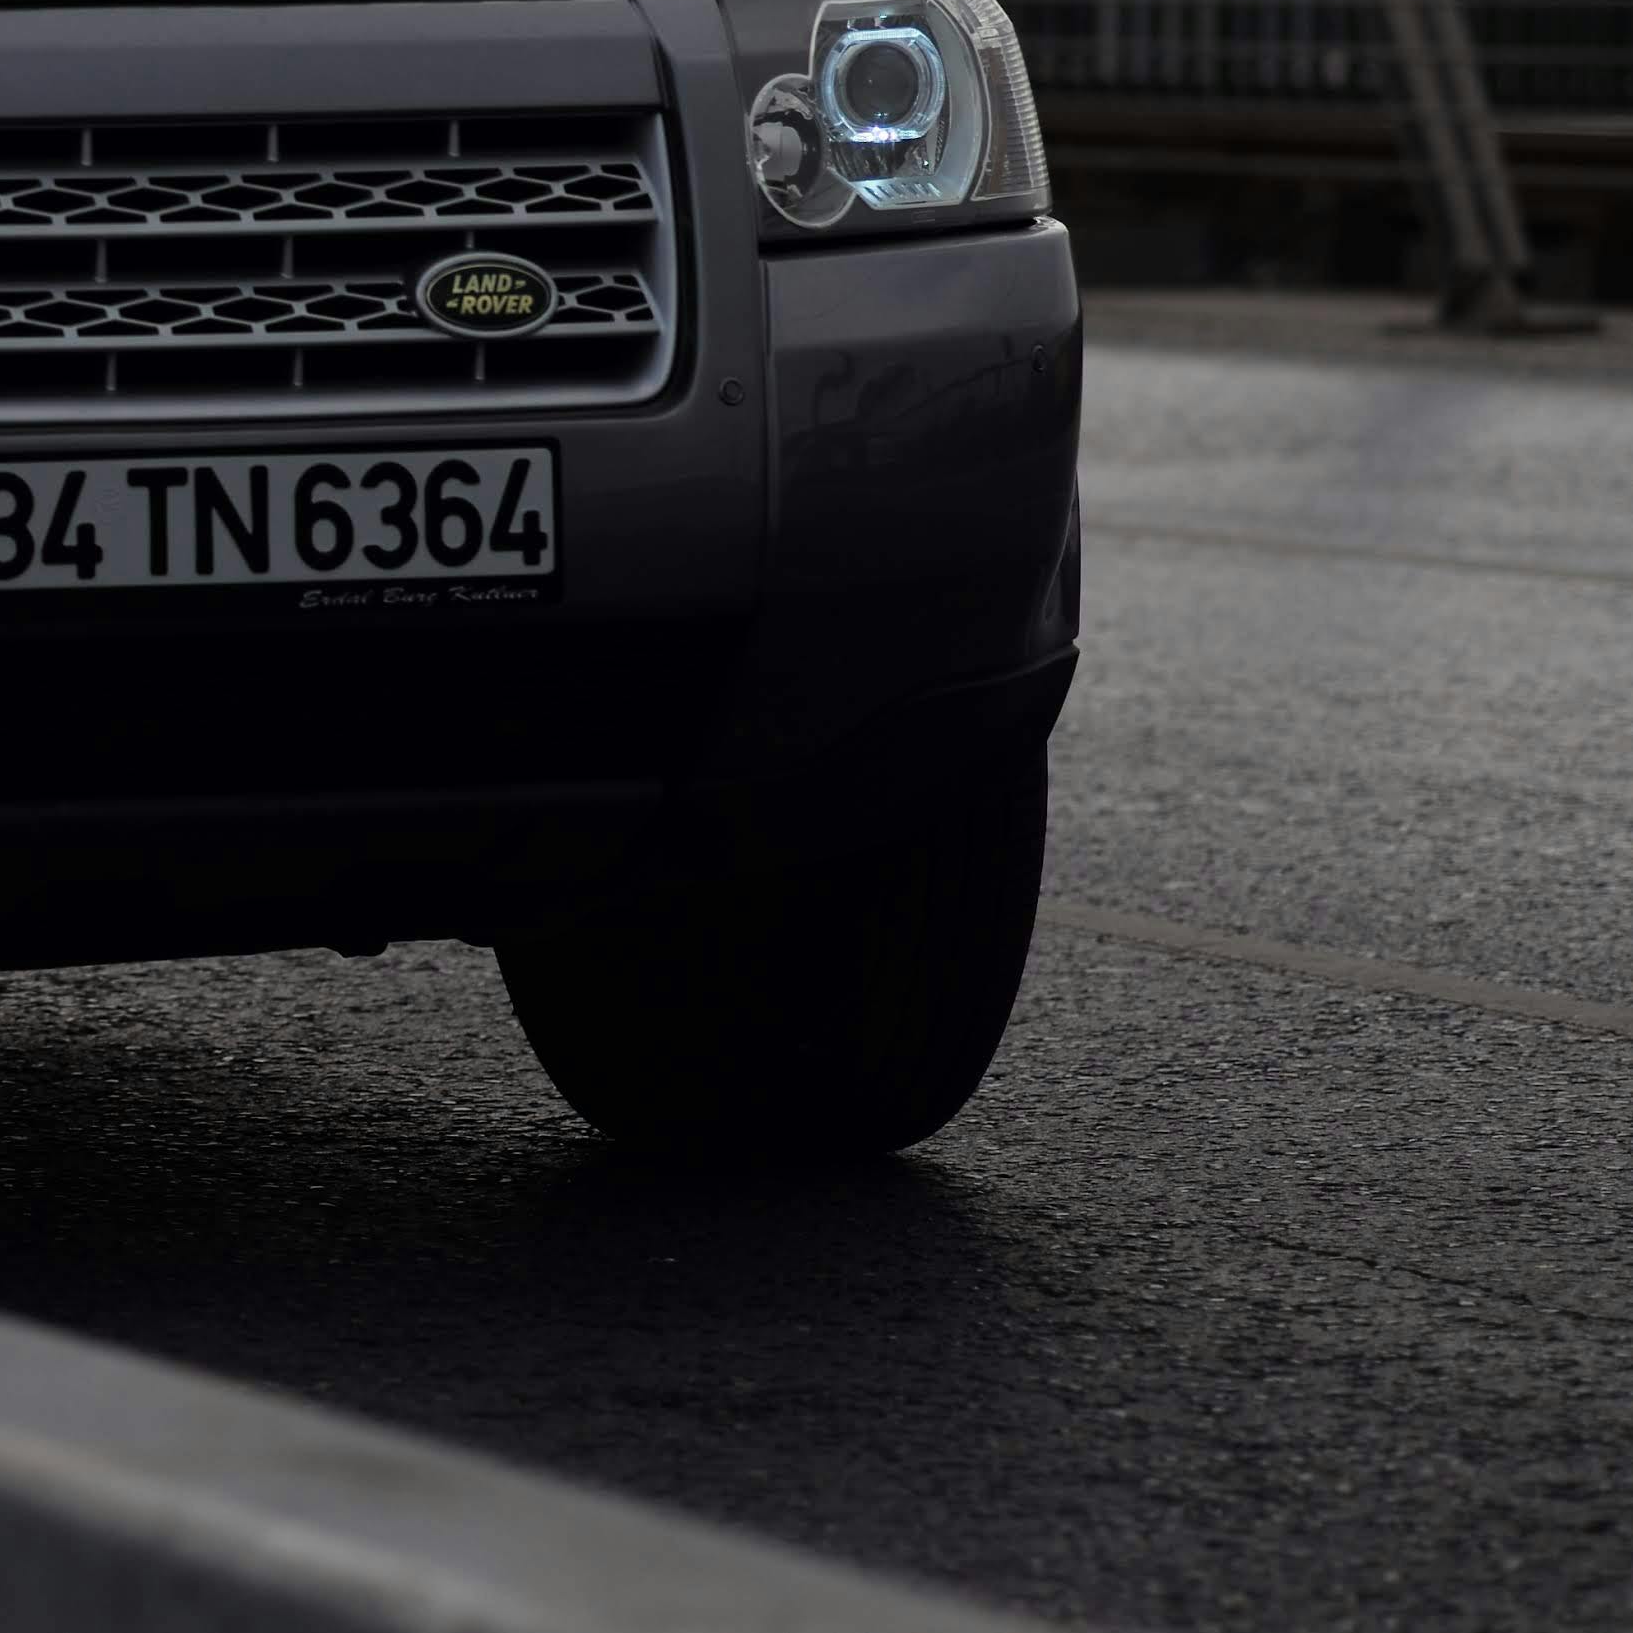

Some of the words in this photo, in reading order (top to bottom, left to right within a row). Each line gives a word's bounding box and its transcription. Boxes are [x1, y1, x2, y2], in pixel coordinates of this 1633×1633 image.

[451, 274, 513, 295] LAND
[459, 294, 534, 315] ROVER
[126, 464, 270, 576] TN
[293, 457, 548, 573] 6364
